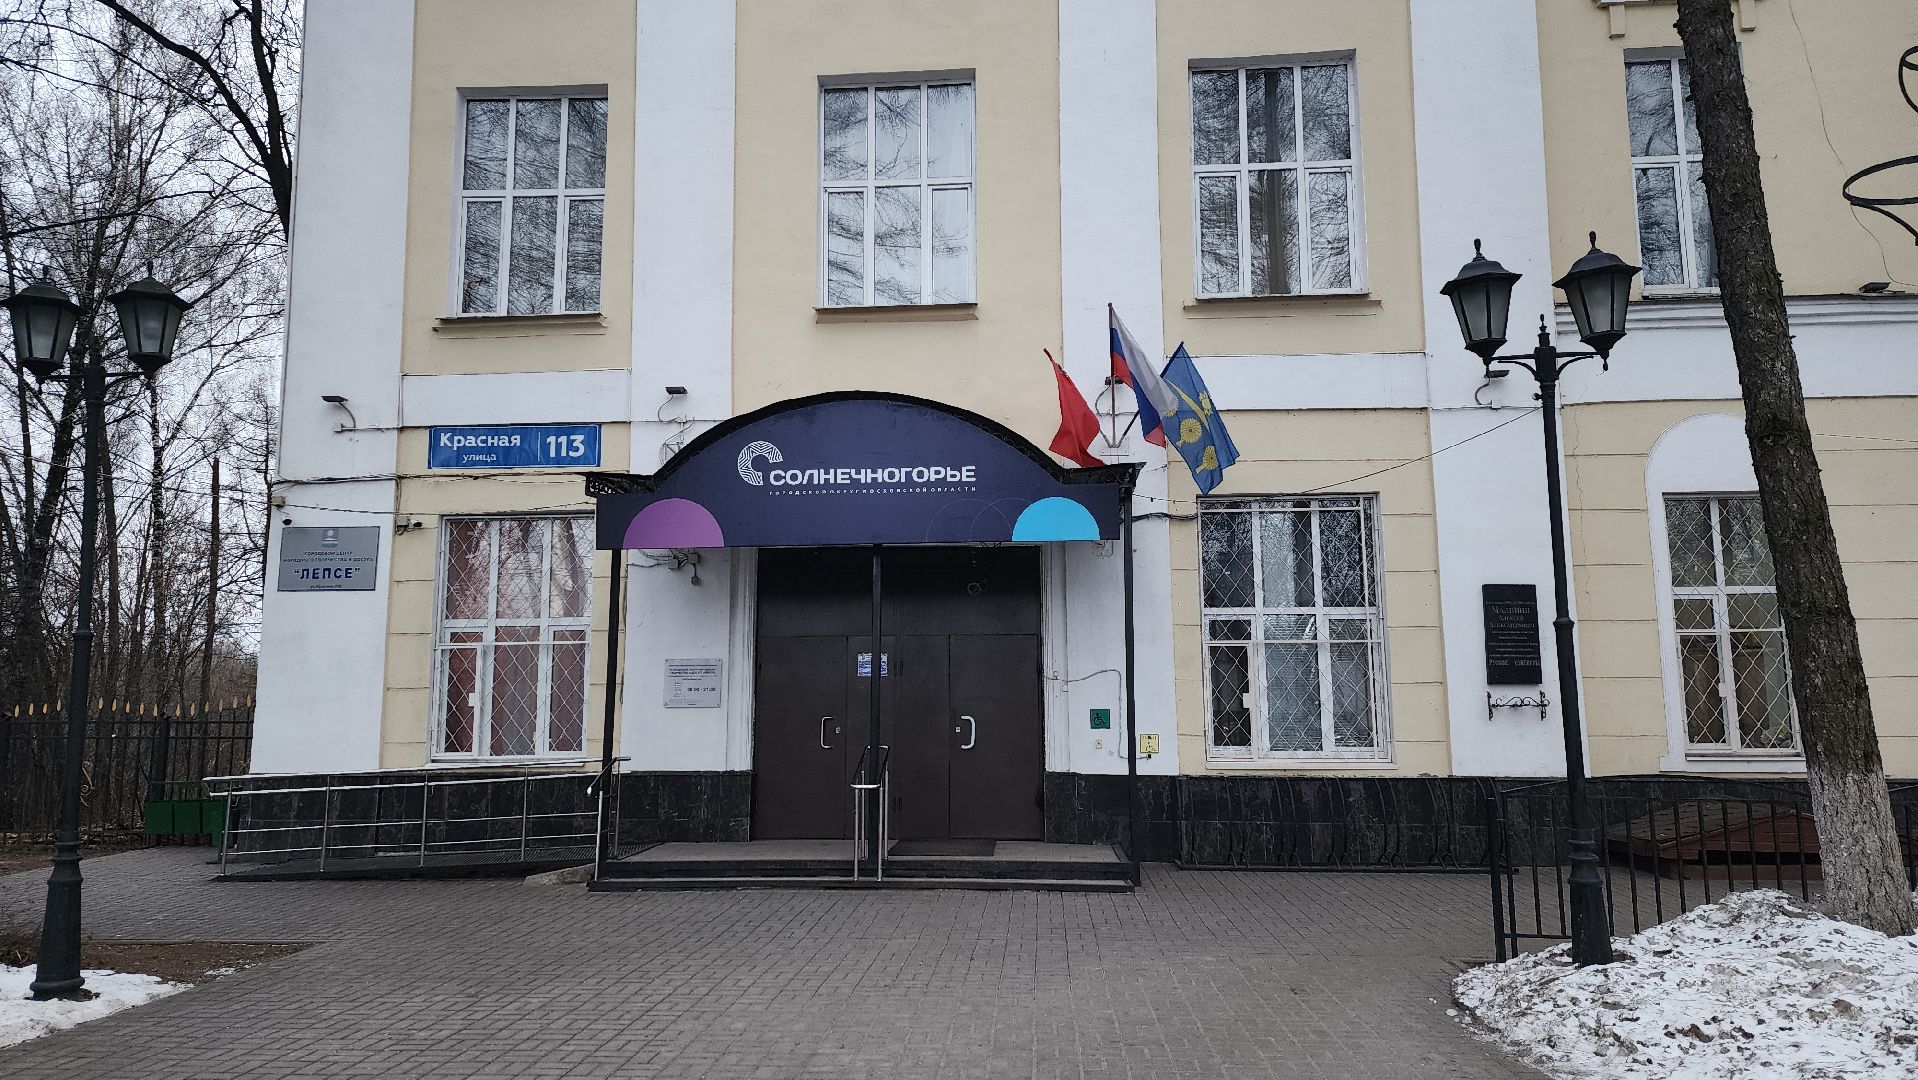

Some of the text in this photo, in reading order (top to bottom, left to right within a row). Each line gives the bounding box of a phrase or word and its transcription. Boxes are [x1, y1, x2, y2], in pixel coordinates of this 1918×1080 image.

[440, 433, 521, 450] Красная
[546, 435, 585, 458] 113
[462, 453, 497, 463] улица
[769, 466, 977, 486] СОЛНЕЧНОГОРЬЕ
